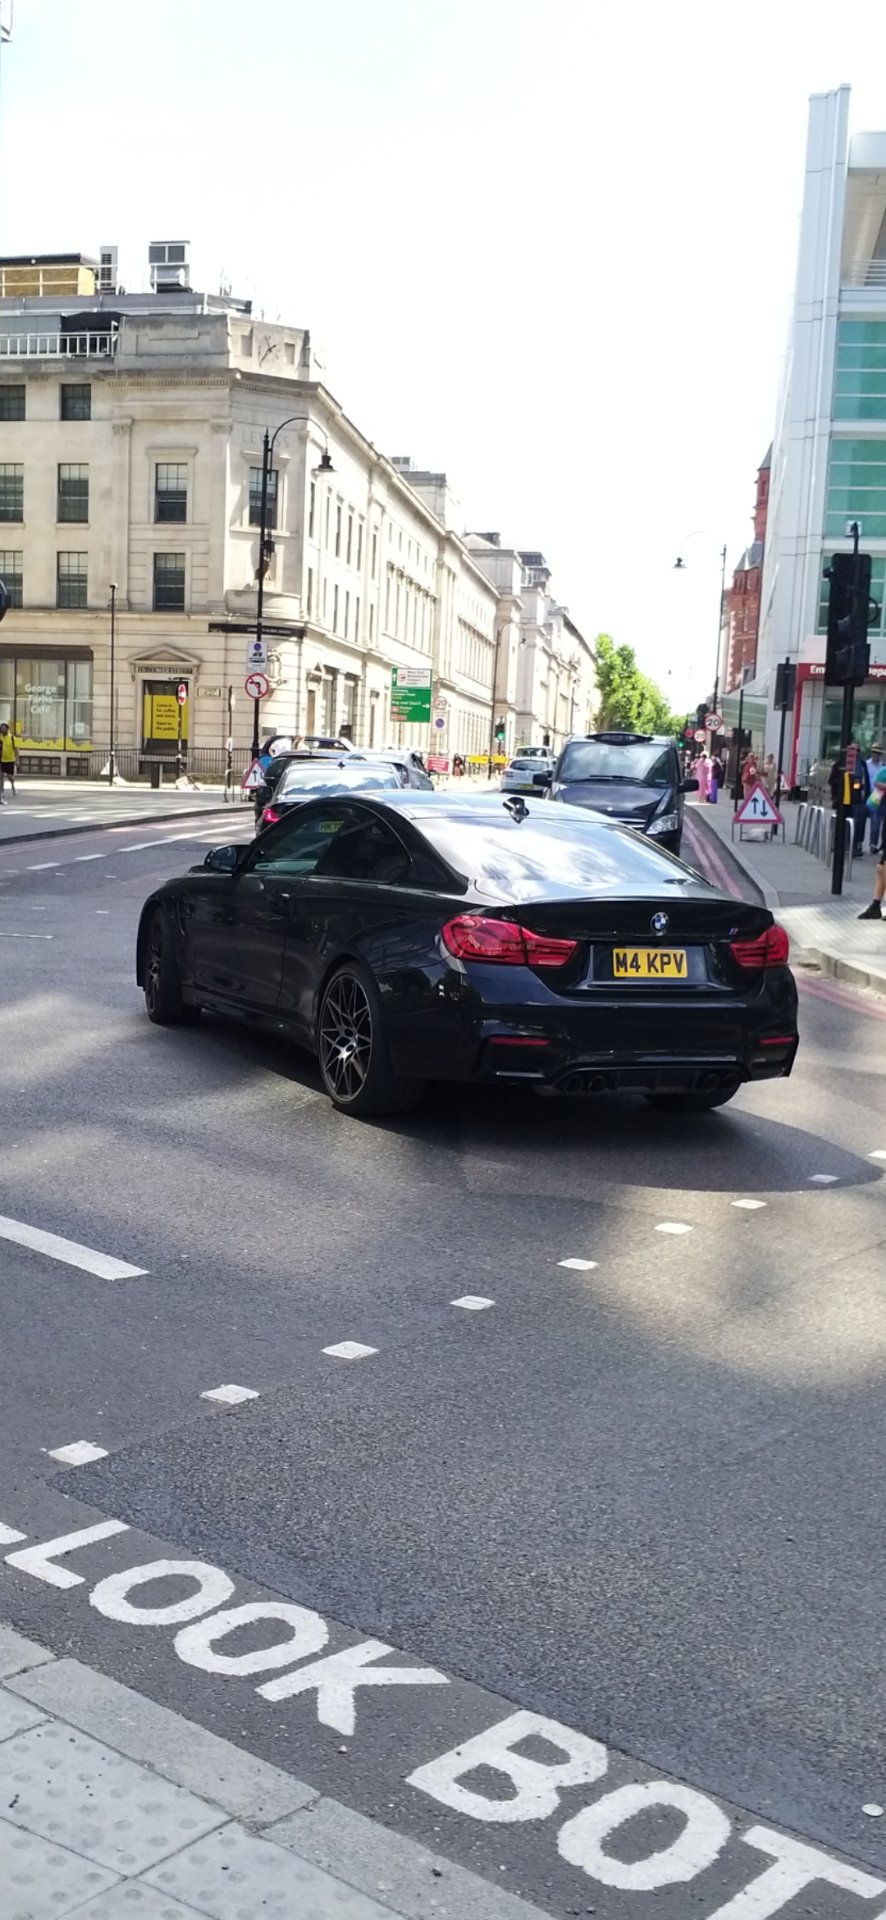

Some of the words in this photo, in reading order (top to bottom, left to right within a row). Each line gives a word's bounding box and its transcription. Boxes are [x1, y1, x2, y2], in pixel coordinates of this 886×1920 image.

[24, 683, 56, 695] George
[707, 719, 720, 727] 20
[615, 952, 641, 973] M4
[646, 953, 684, 974] KPV
[4, 1519, 450, 1736] LOOK
[404, 1710, 886, 1920] BOT
